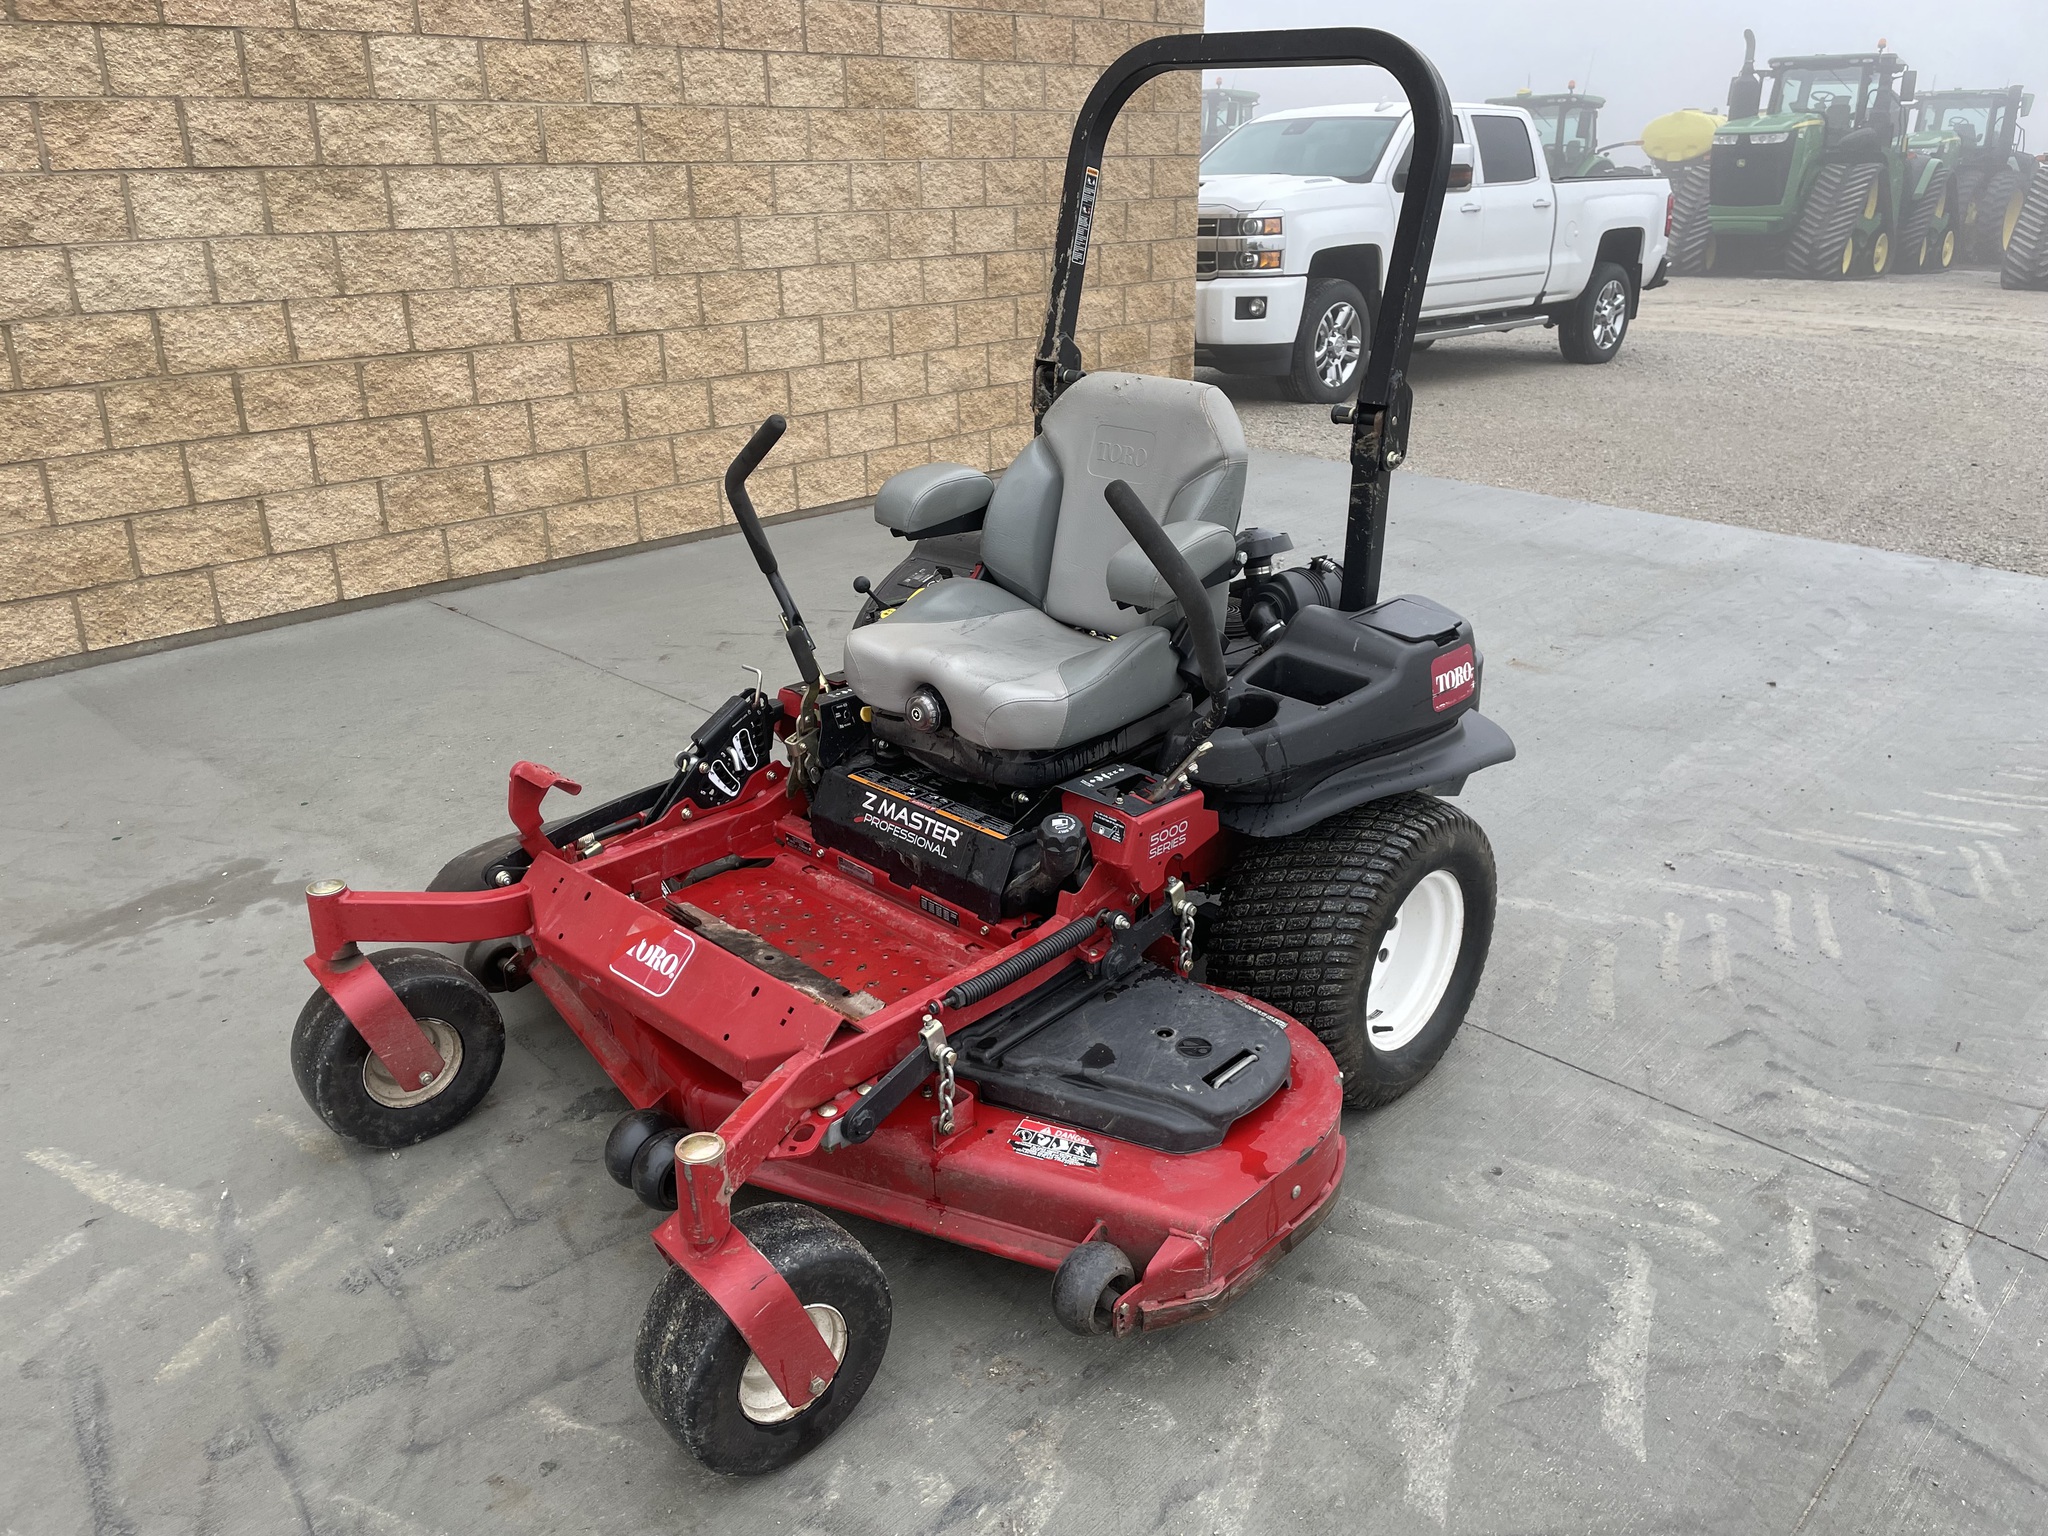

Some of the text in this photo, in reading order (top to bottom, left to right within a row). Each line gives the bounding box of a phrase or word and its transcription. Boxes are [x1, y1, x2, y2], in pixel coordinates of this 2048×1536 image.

[1097, 440, 1148, 468] TORO
[1435, 661, 1473, 693] TORO
[861, 791, 878, 811] Z
[877, 798, 960, 847] MASTER
[1150, 820, 1189, 847] 5000
[863, 813, 948, 859] PROFESSIONAL
[1149, 833, 1187, 860] SERIES
